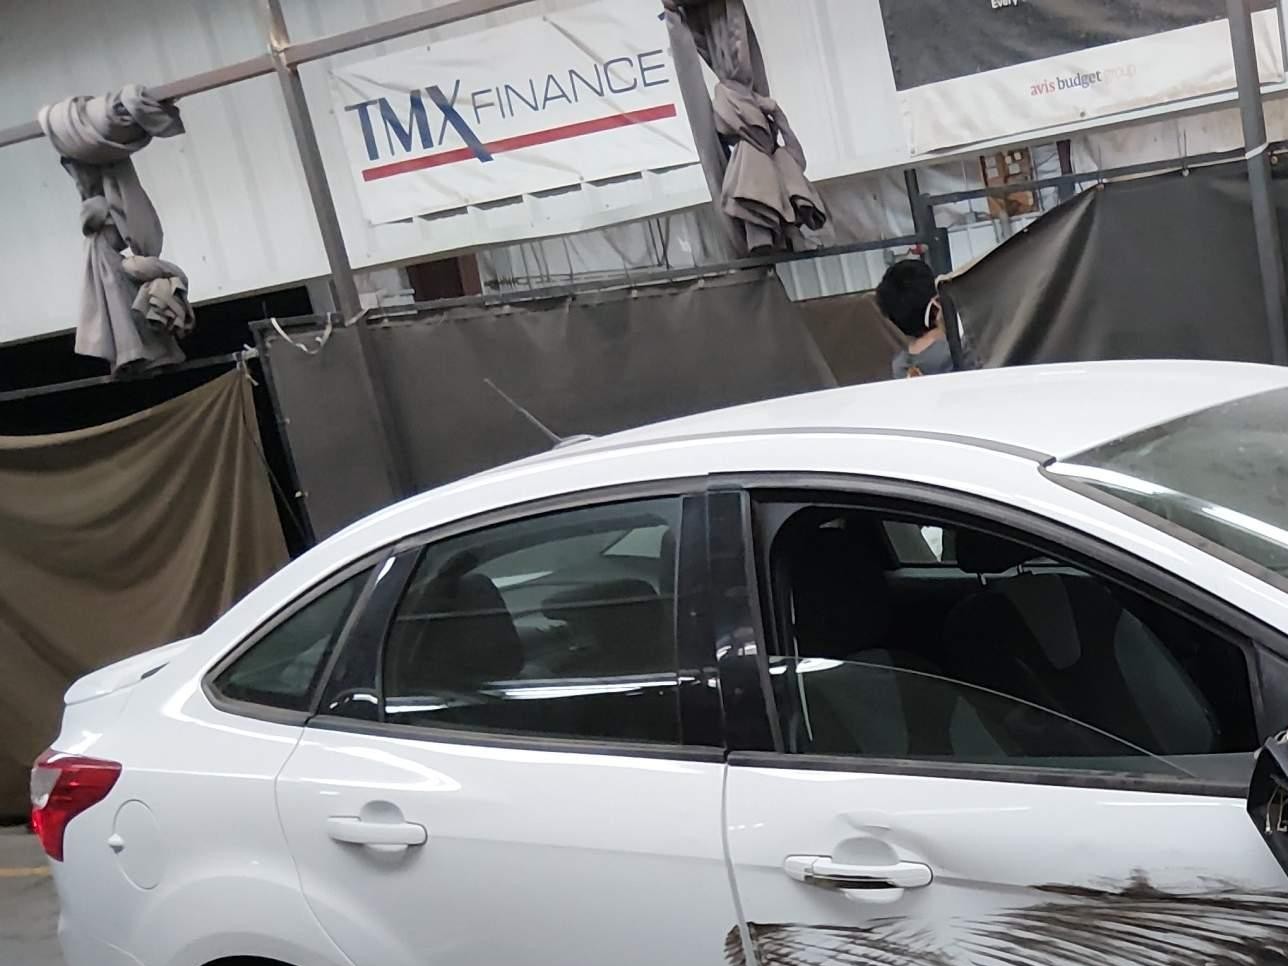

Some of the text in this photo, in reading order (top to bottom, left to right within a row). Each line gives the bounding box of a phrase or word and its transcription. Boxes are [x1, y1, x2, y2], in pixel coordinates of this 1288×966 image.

[344, 49, 670, 163] TMX FINANCE
[1030, 80, 1056, 96] avis
[1055, 70, 1102, 90] budget
